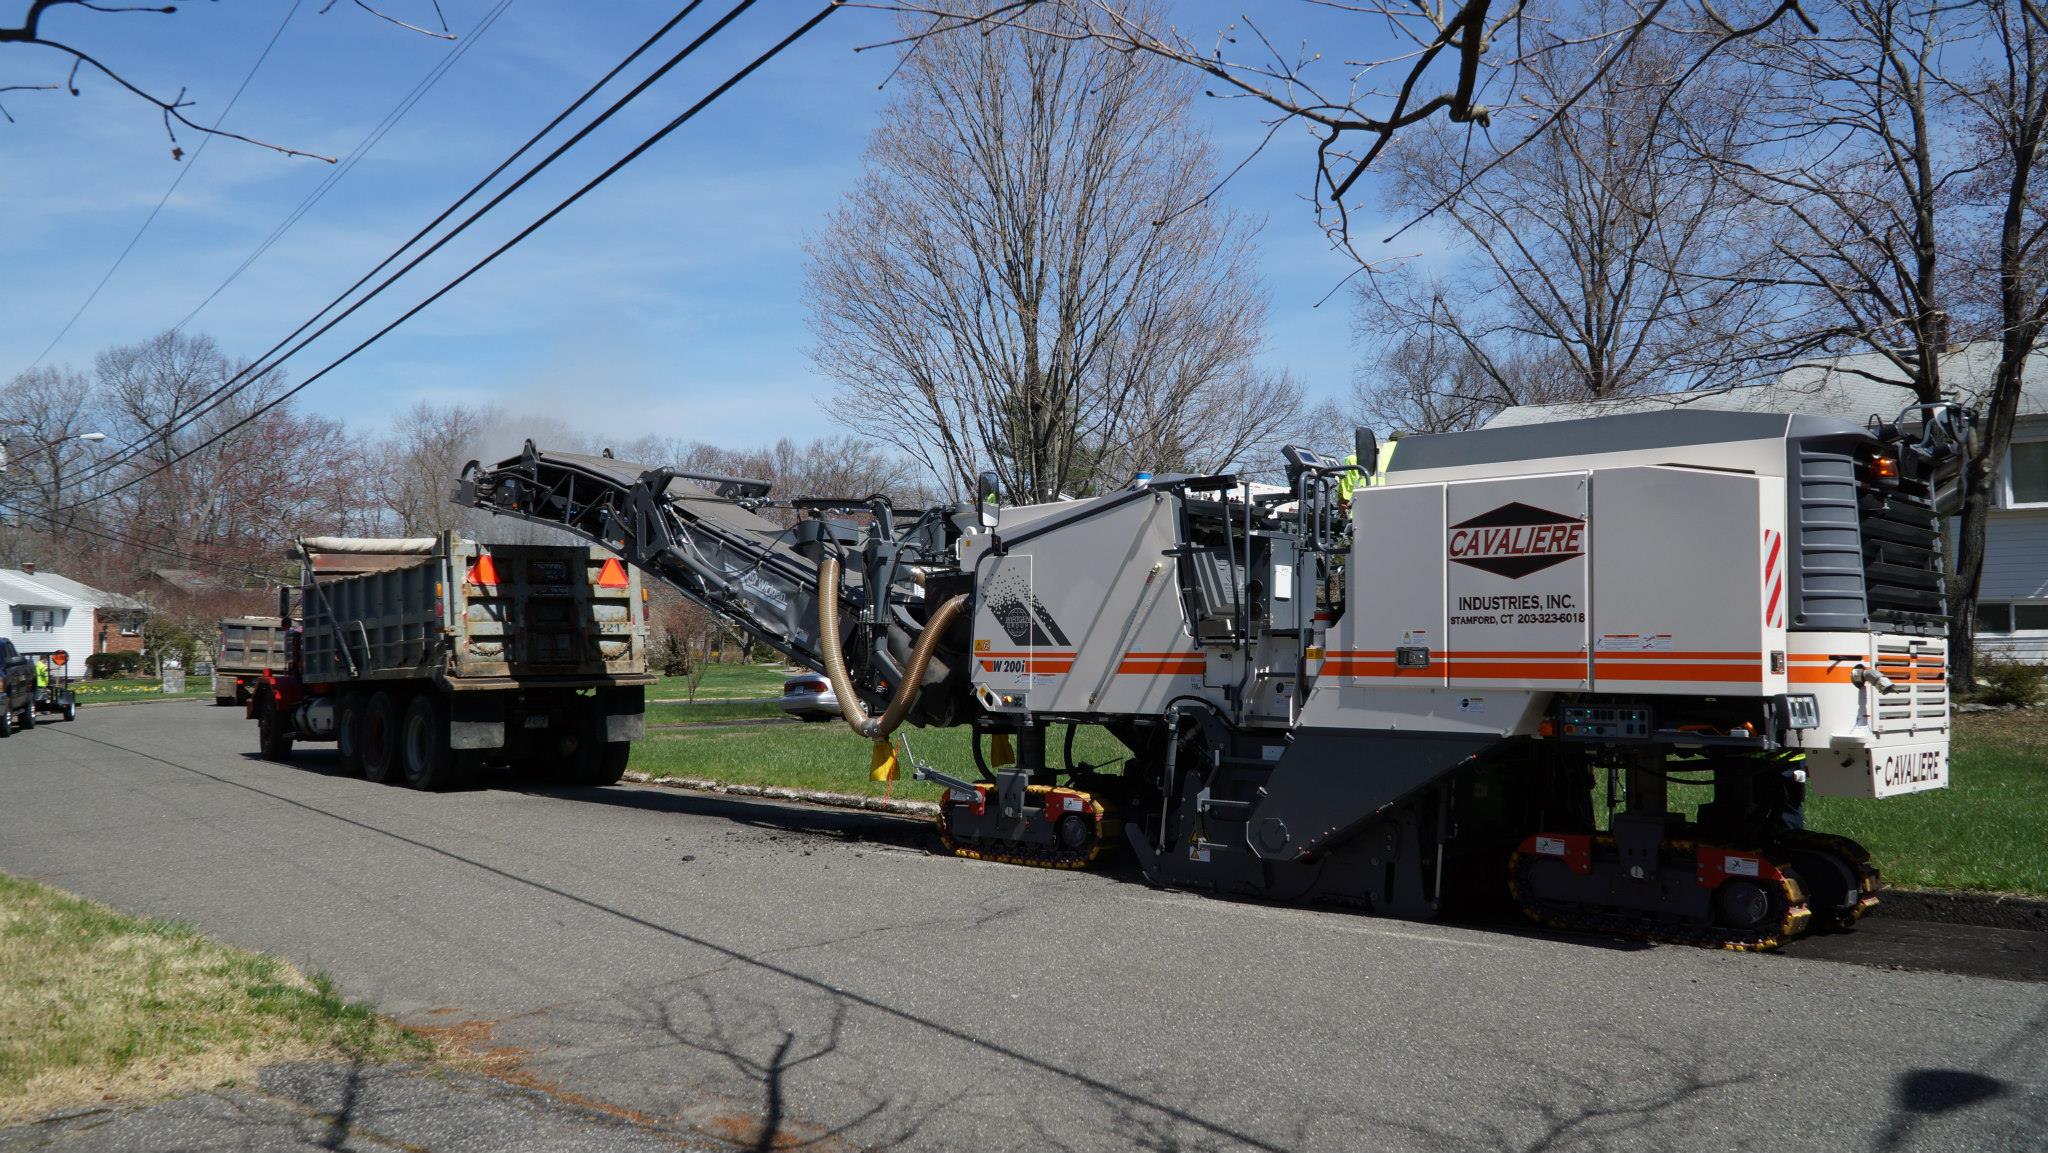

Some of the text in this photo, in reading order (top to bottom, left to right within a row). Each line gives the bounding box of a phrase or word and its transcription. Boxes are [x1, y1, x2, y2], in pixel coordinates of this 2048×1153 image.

[1450, 525, 1584, 557] CAVALIERE
[1459, 594, 1575, 611] INDUSTRIES, INC.
[1450, 613, 1585, 625] STAMFORD, CT 203-323-6018
[993, 660, 1025, 672] W 200i
[1885, 751, 1939, 787] CAVALIERE
